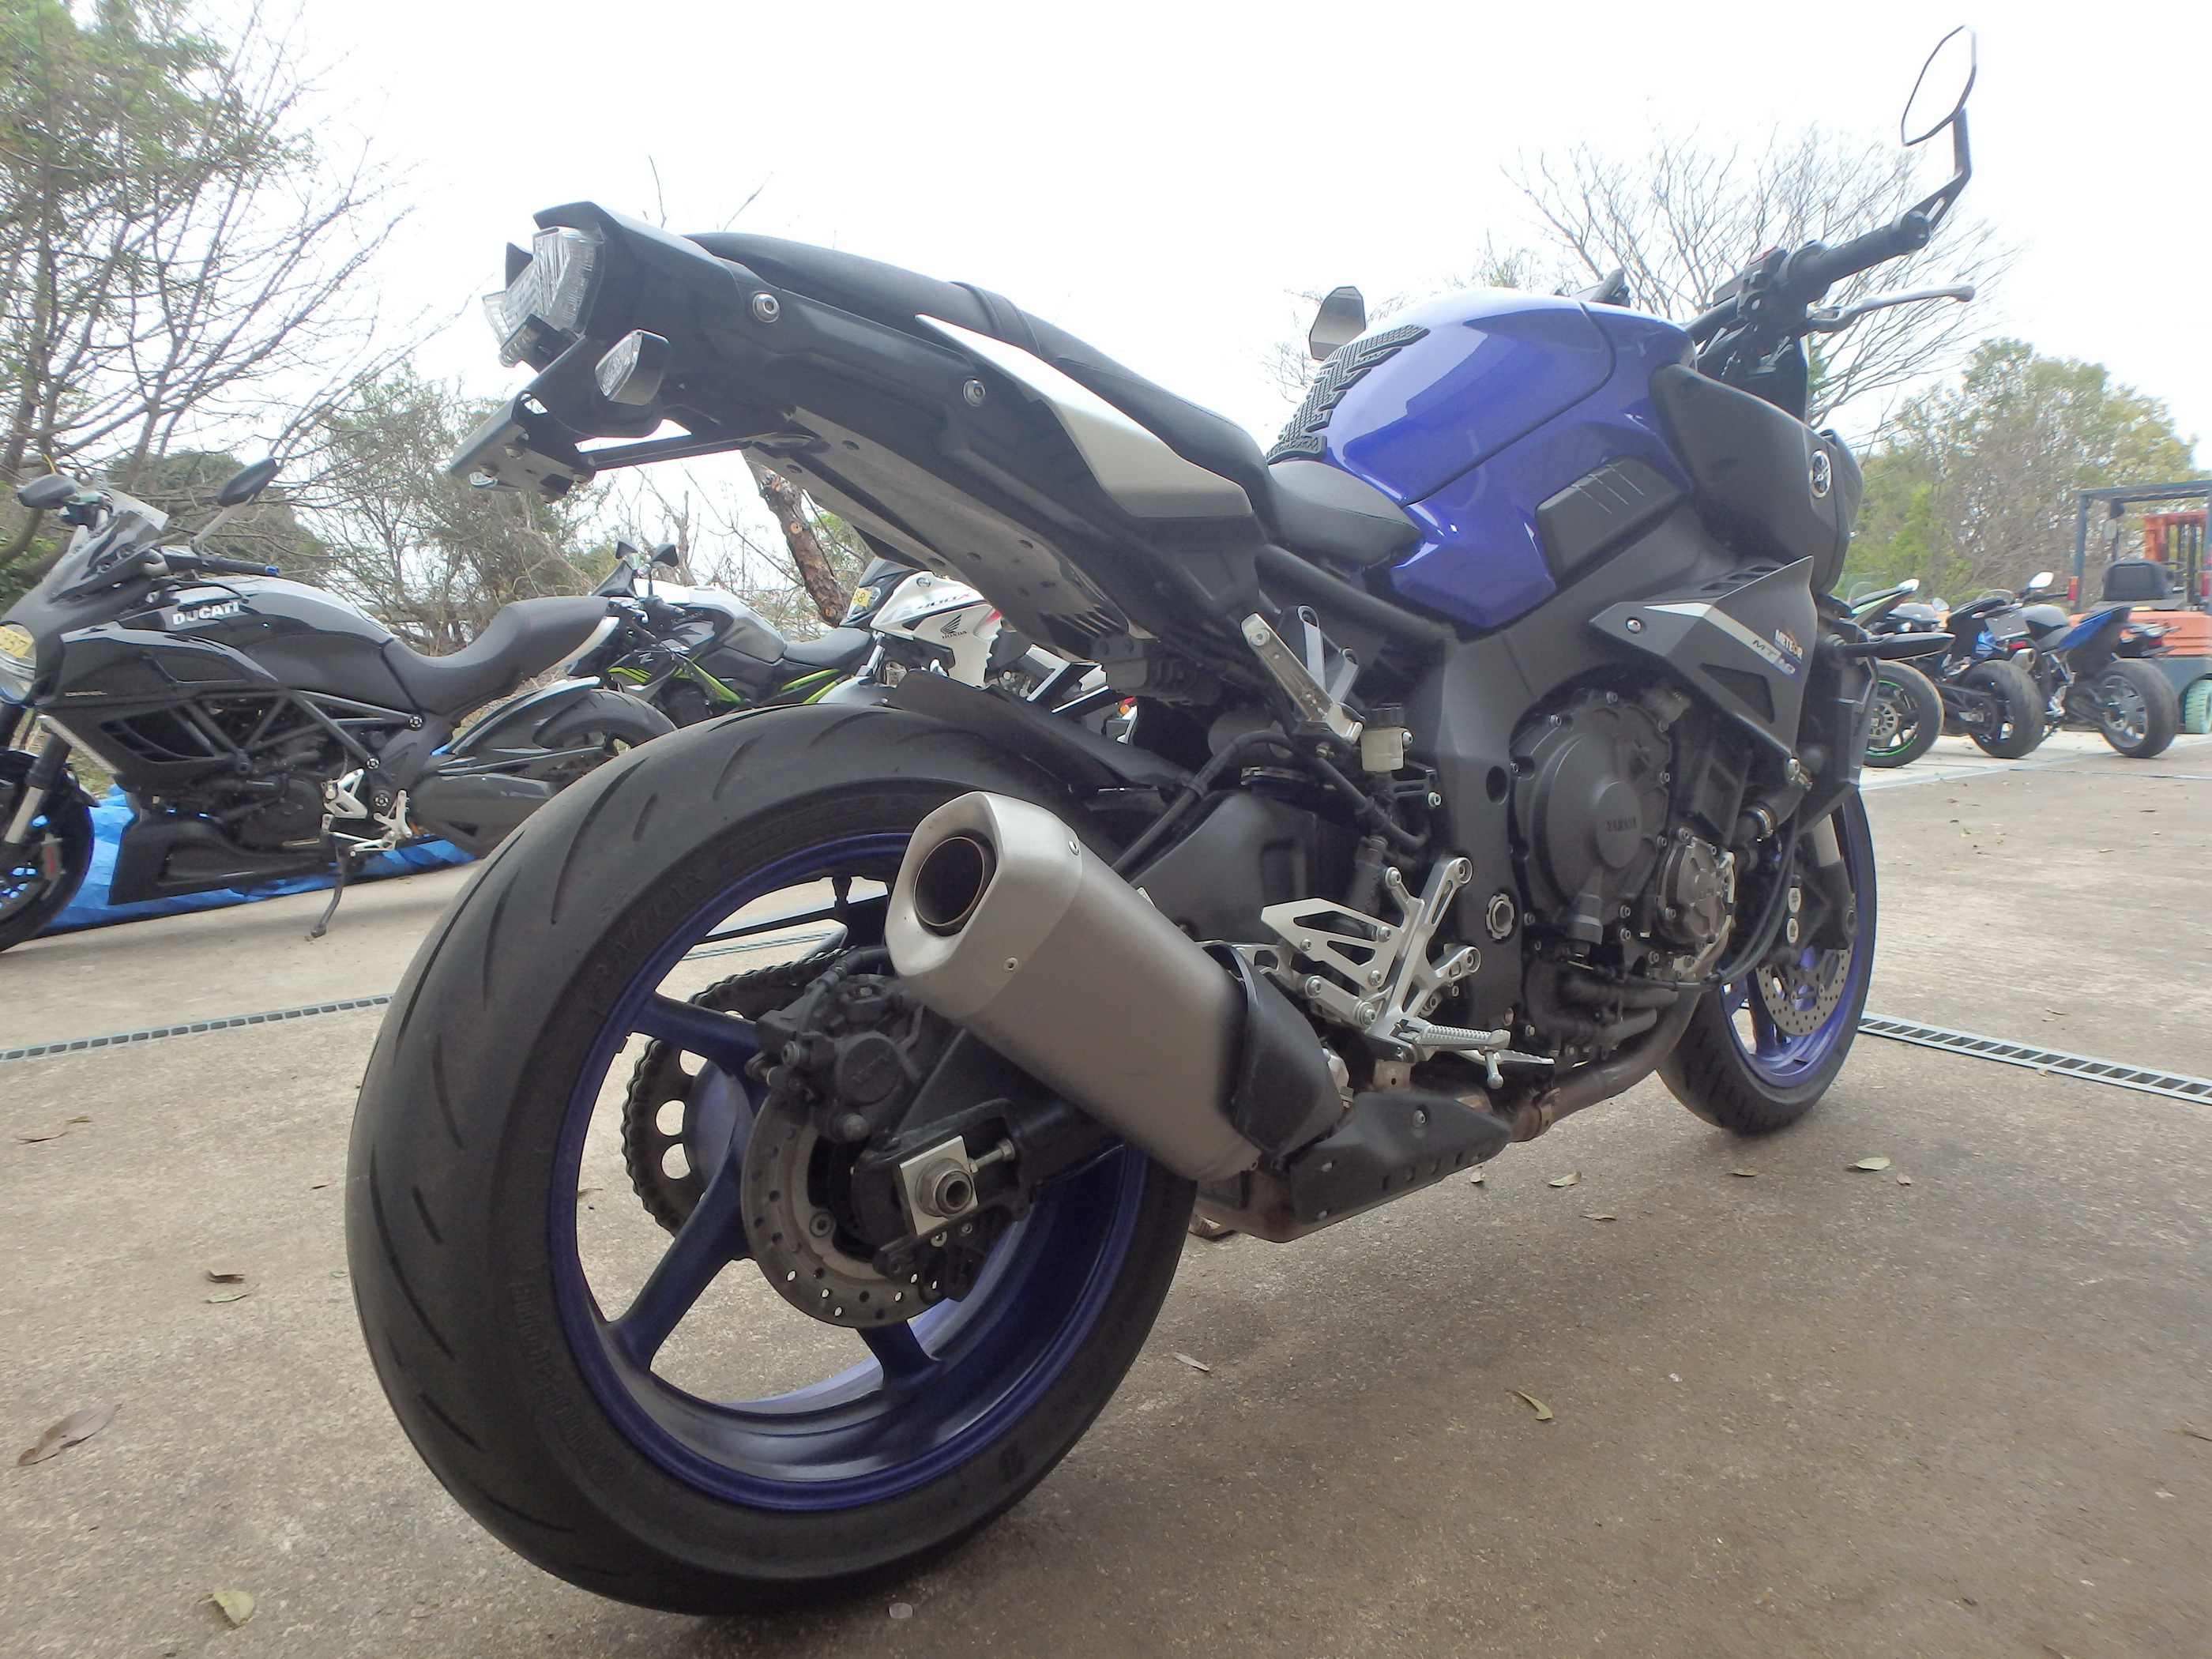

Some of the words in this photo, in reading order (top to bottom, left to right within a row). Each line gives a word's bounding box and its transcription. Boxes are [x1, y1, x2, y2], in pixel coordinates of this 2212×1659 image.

[172, 601, 239, 626] DUCATI
[942, 630, 968, 639] HONDA
[1774, 629, 1803, 660] METEOR
